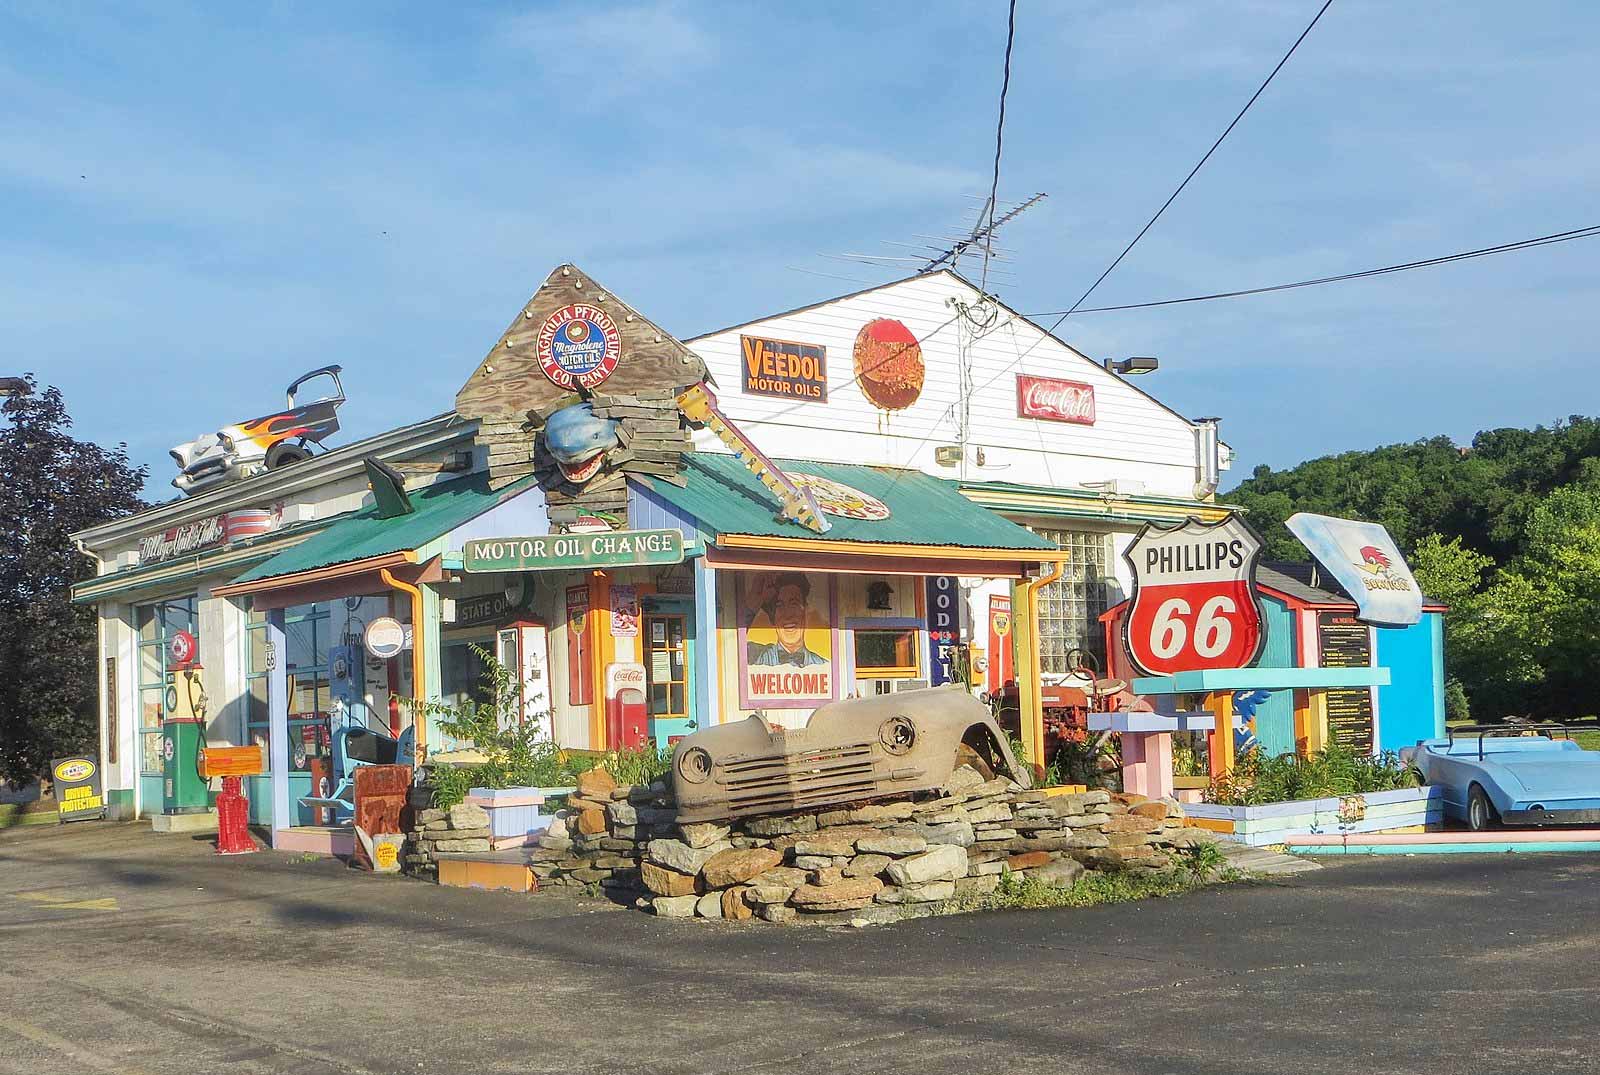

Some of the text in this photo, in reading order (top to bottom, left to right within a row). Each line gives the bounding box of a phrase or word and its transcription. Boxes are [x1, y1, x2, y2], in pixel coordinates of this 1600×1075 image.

[540, 306, 619, 369] MAGNOLIA PETROLEUM
[558, 354, 583, 366] MOTOR
[743, 336, 825, 382] VEEDOL
[748, 377, 821, 397] MOTOR OILS
[1026, 382, 1093, 418] Coca-Cola
[473, 534, 673, 561] MOTOR OIL CHANGE
[1146, 539, 1243, 574] PHILLIPS
[462, 601, 492, 621] STATE
[936, 576, 950, 627] OOD
[1149, 595, 1237, 660] 66
[266, 652, 275, 667] 66
[750, 673, 829, 694] WELCOME
